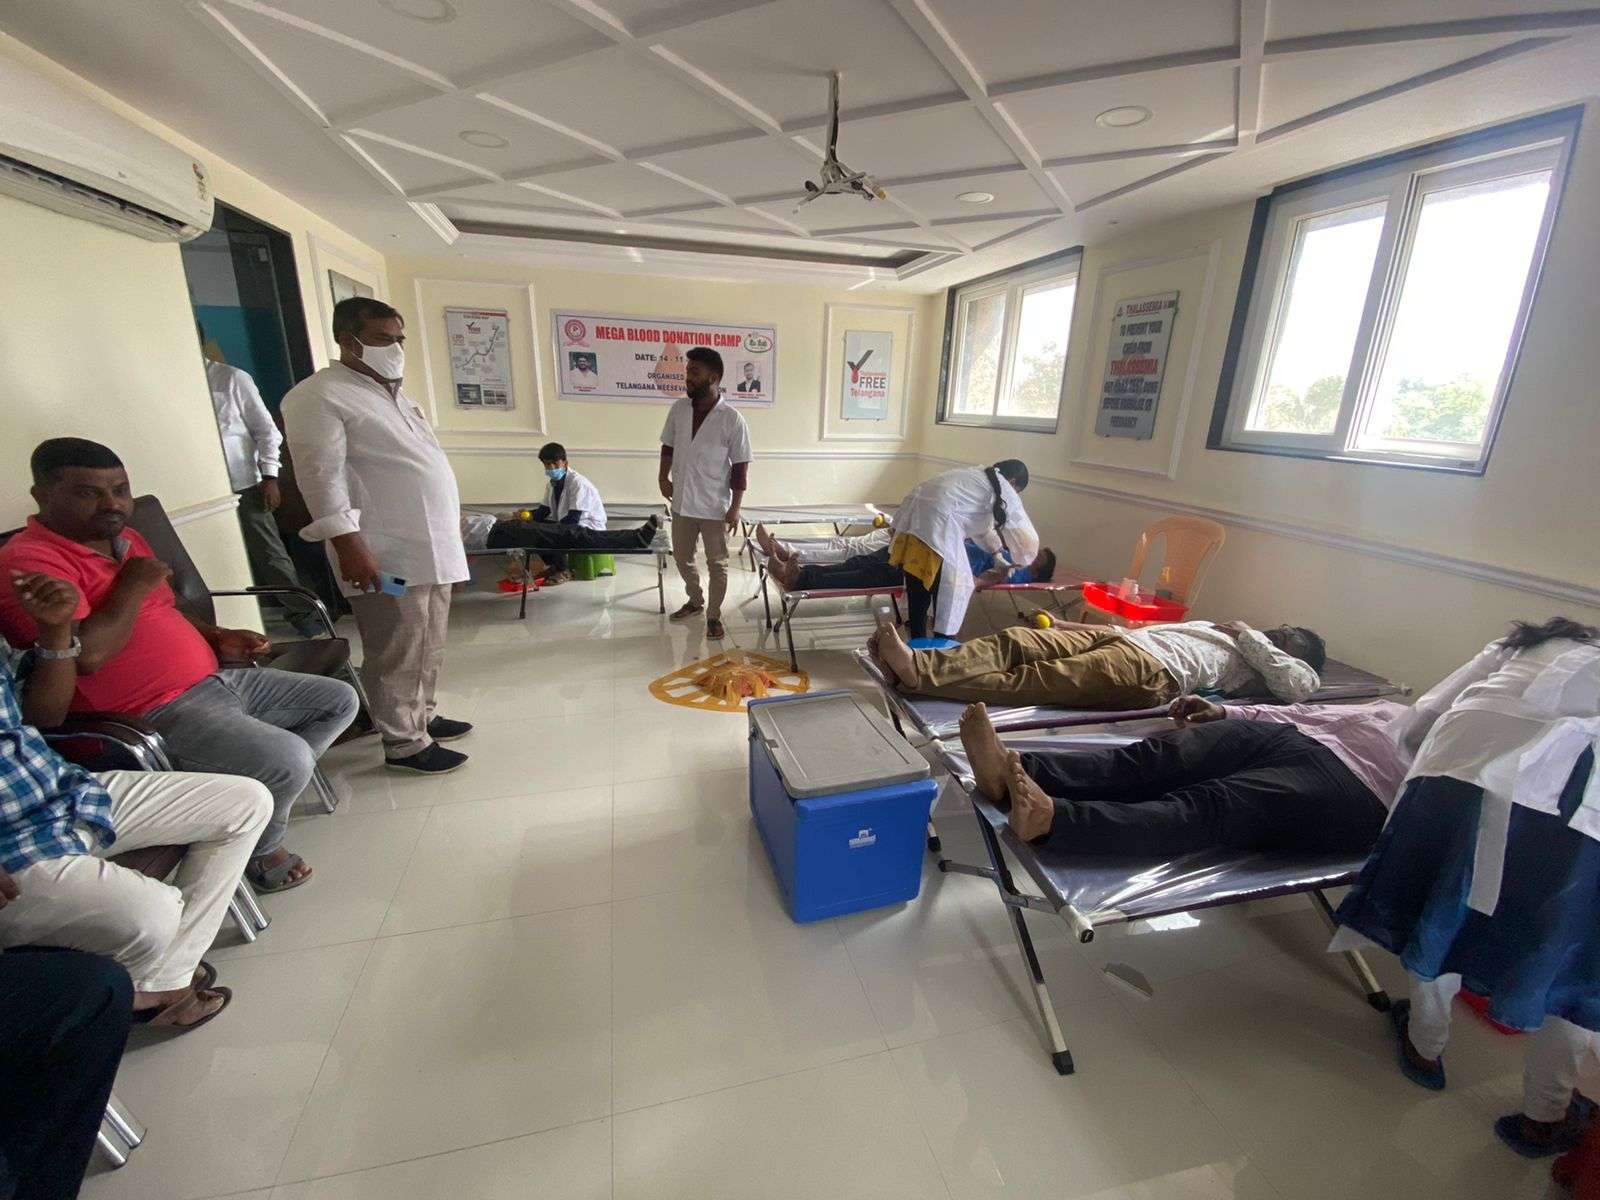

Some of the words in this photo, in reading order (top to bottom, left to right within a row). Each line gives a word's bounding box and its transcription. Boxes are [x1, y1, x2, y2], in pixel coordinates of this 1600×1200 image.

[596, 326, 625, 340] MEGA
[627, 328, 660, 342] BLOOD
[662, 330, 712, 346] DONATION
[714, 333, 741, 347] CAMP
[616, 382, 655, 390] TELANGANA
[860, 376, 887, 389] FREE
